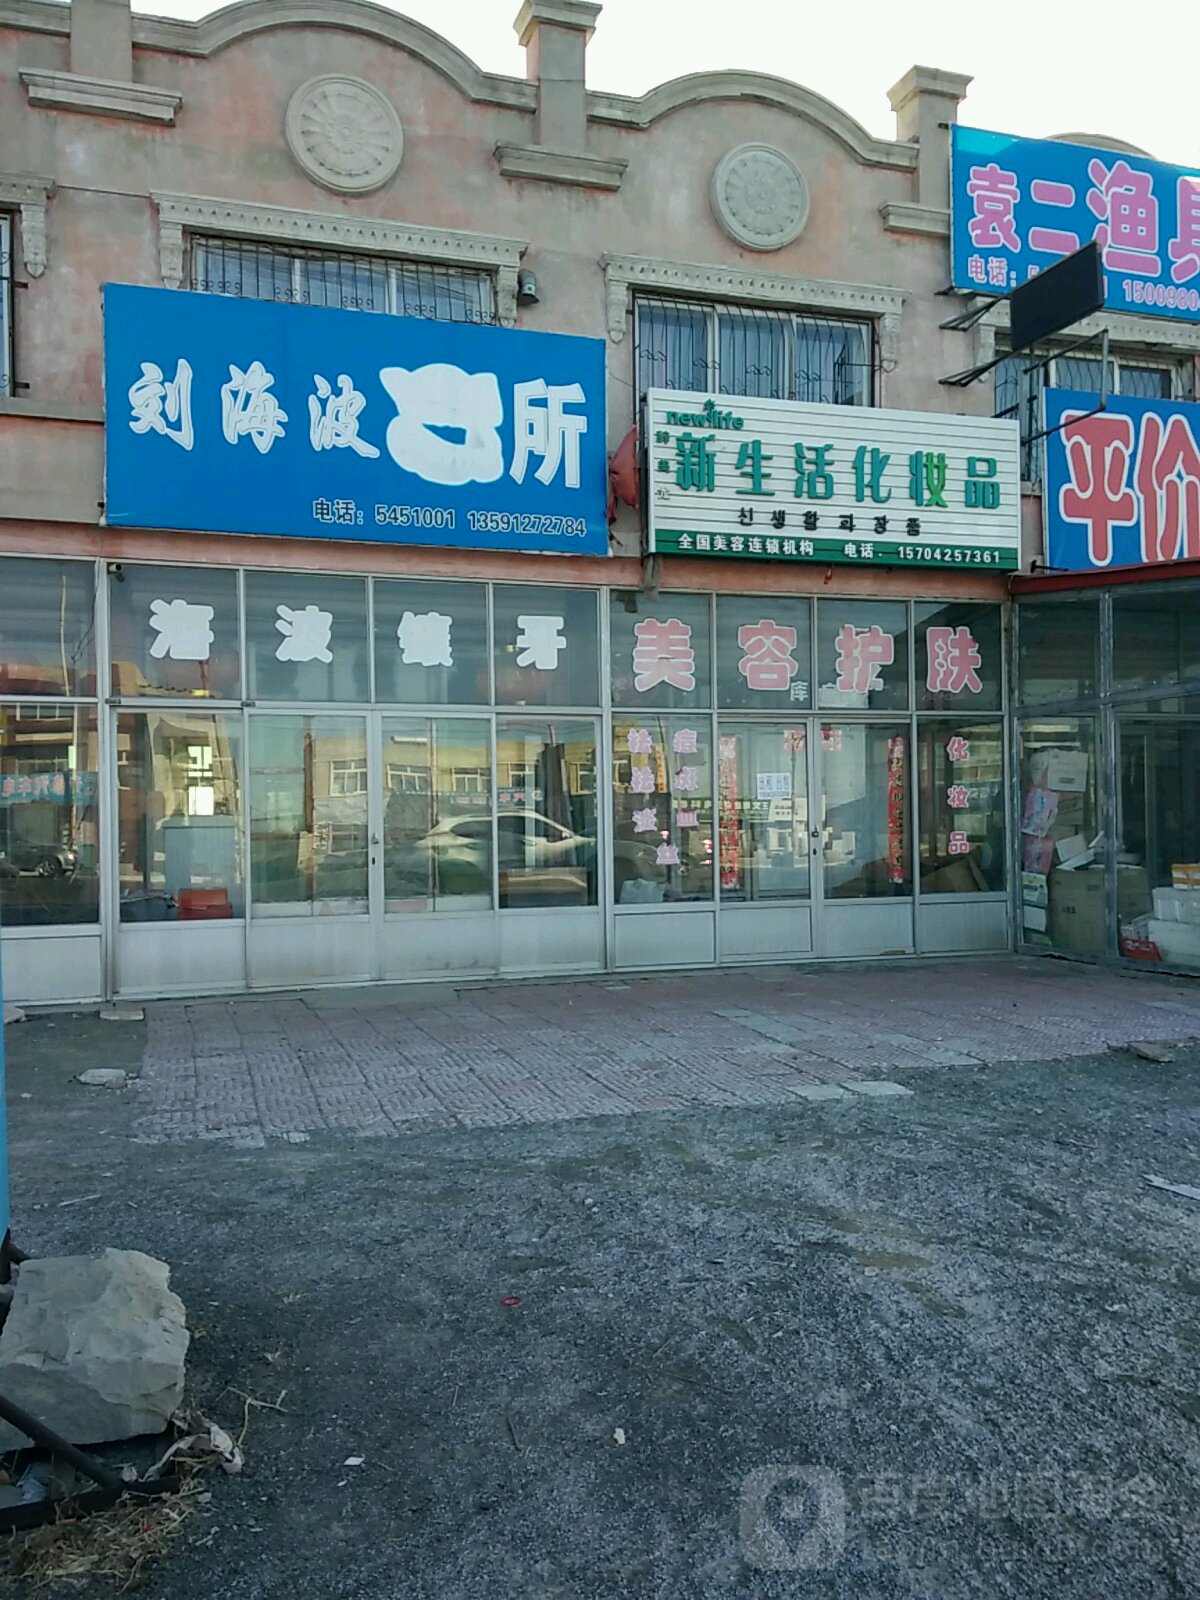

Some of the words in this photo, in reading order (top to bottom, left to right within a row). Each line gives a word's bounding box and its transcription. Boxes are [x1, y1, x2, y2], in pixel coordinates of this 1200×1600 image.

[674, 431, 1001, 510] 新生活化妆品
[375, 504, 456, 529] 5451001
[467, 511, 587, 537] 13591272784
[678, 533, 815, 557] 全国美容连锁机构
[898, 546, 1000, 564] 15704257361
[633, 618, 983, 694] 美容护肤
